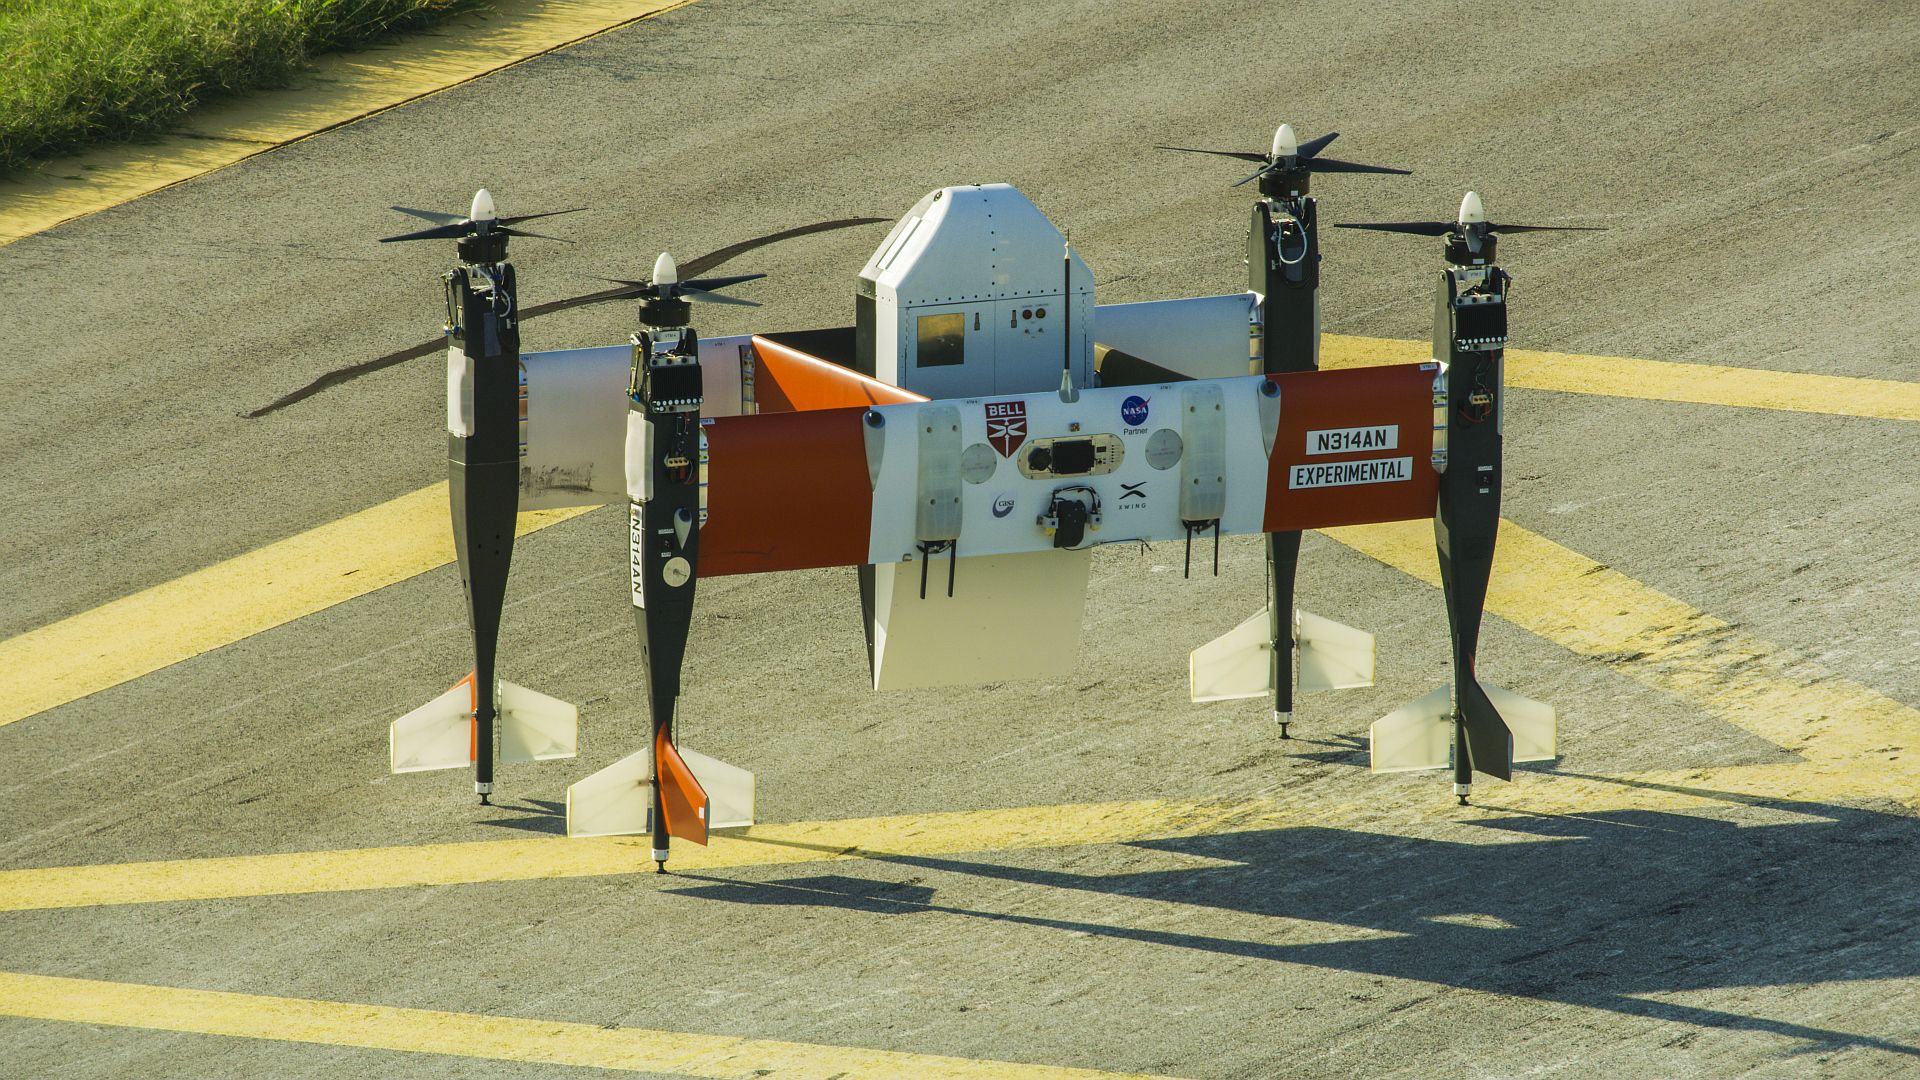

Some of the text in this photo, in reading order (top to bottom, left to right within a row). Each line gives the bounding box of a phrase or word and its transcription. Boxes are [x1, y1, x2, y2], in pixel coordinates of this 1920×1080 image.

[988, 403, 1024, 416] BELL
[1123, 406, 1148, 416] NASA
[1123, 428, 1148, 436] Partner
[1317, 429, 1387, 451] N314AN
[1296, 460, 1405, 486] EXPERIMENTAL
[1118, 502, 1147, 510] XWING
[632, 518, 642, 594] N314AN
